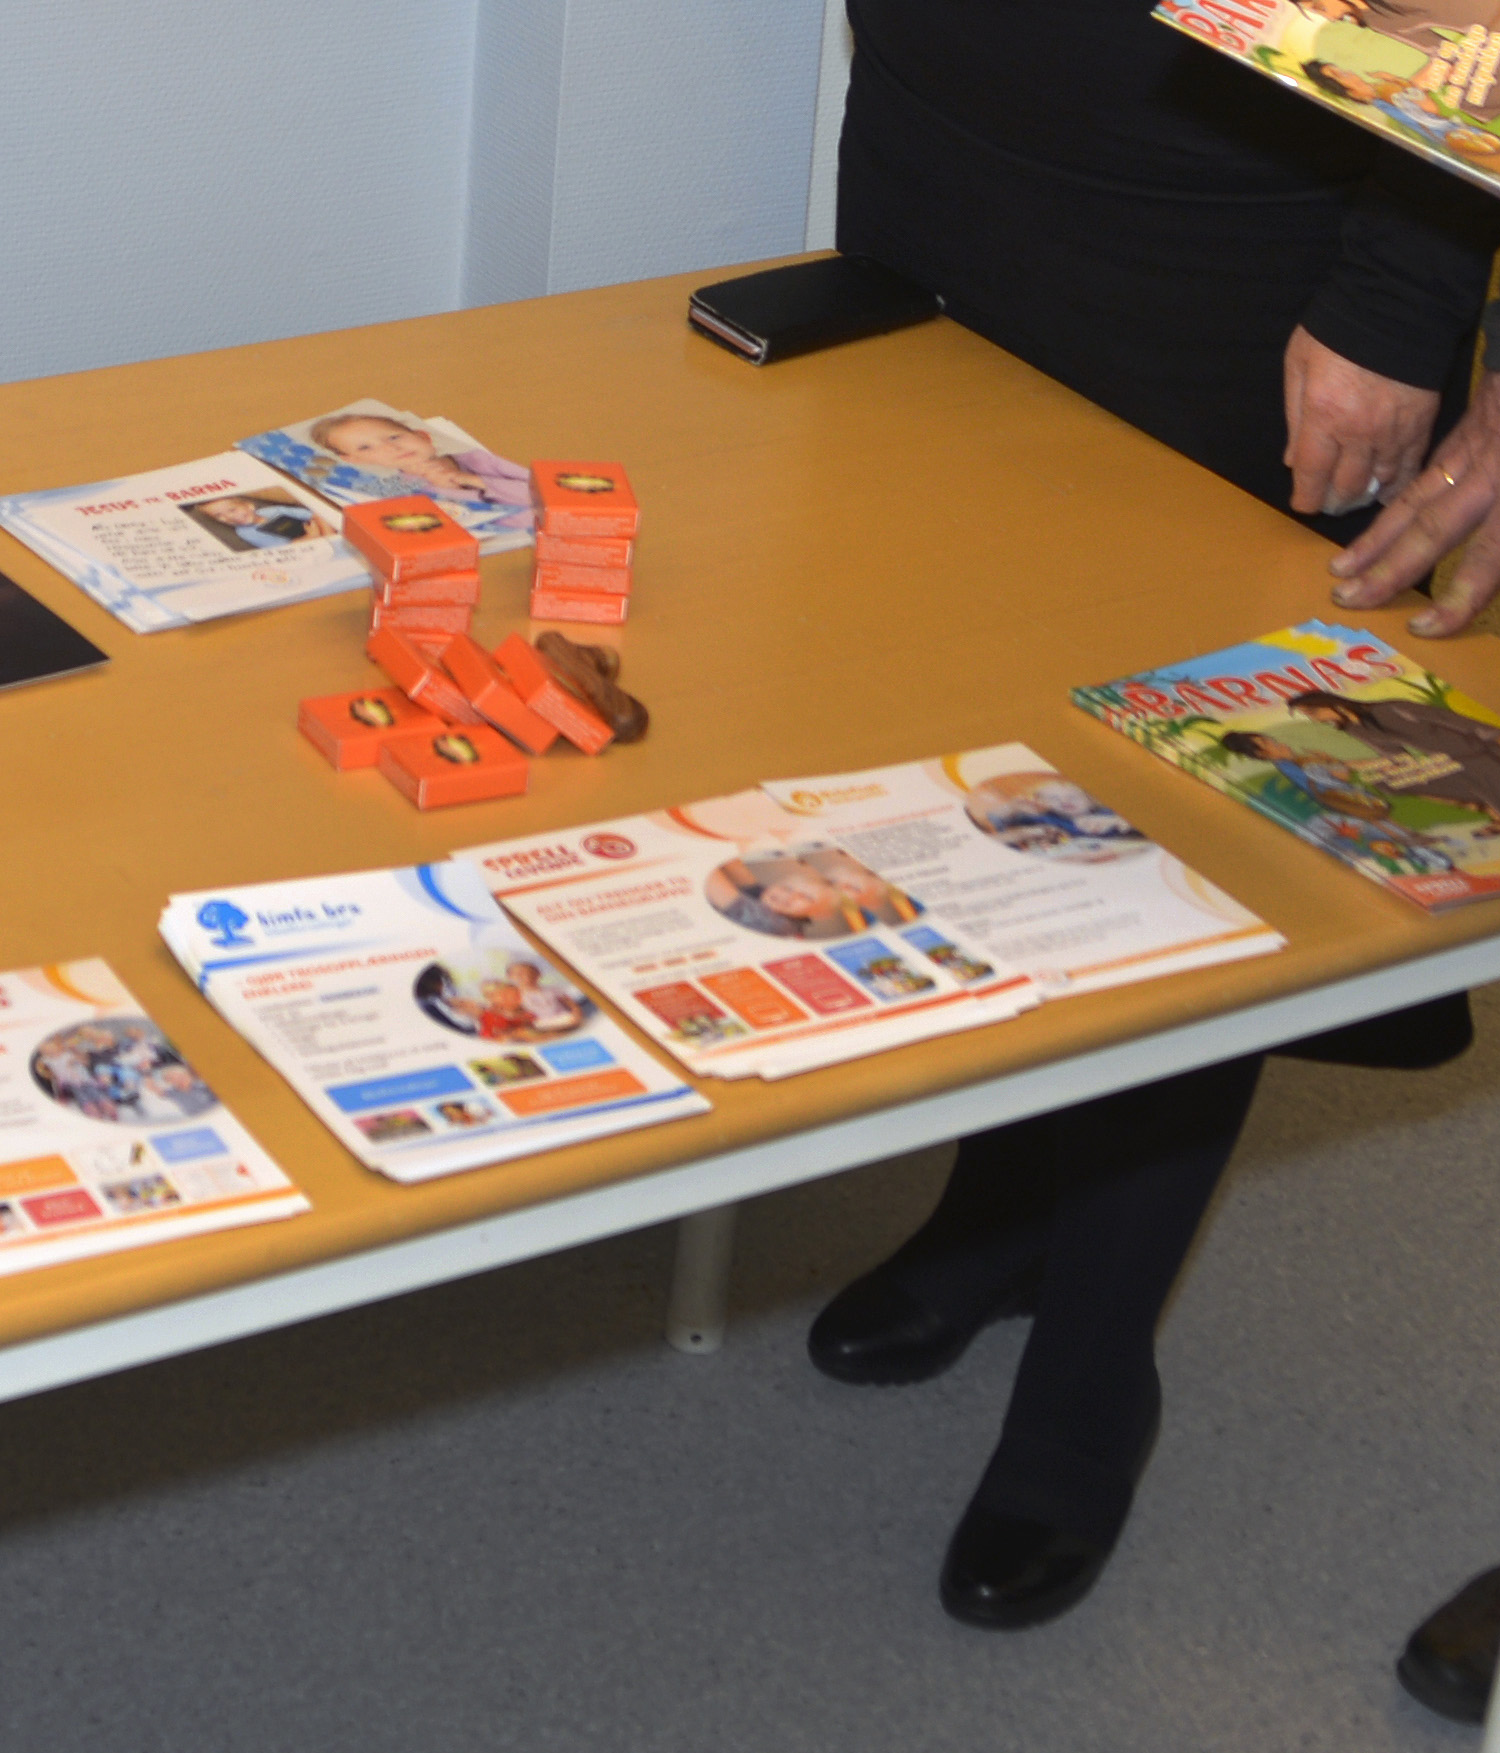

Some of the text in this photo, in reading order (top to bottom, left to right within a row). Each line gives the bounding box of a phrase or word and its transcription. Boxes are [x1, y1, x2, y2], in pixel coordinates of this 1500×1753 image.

[75, 498, 139, 516] JESUS
[165, 478, 238, 501] BARNA
[1124, 644, 1400, 719] BARNAS
